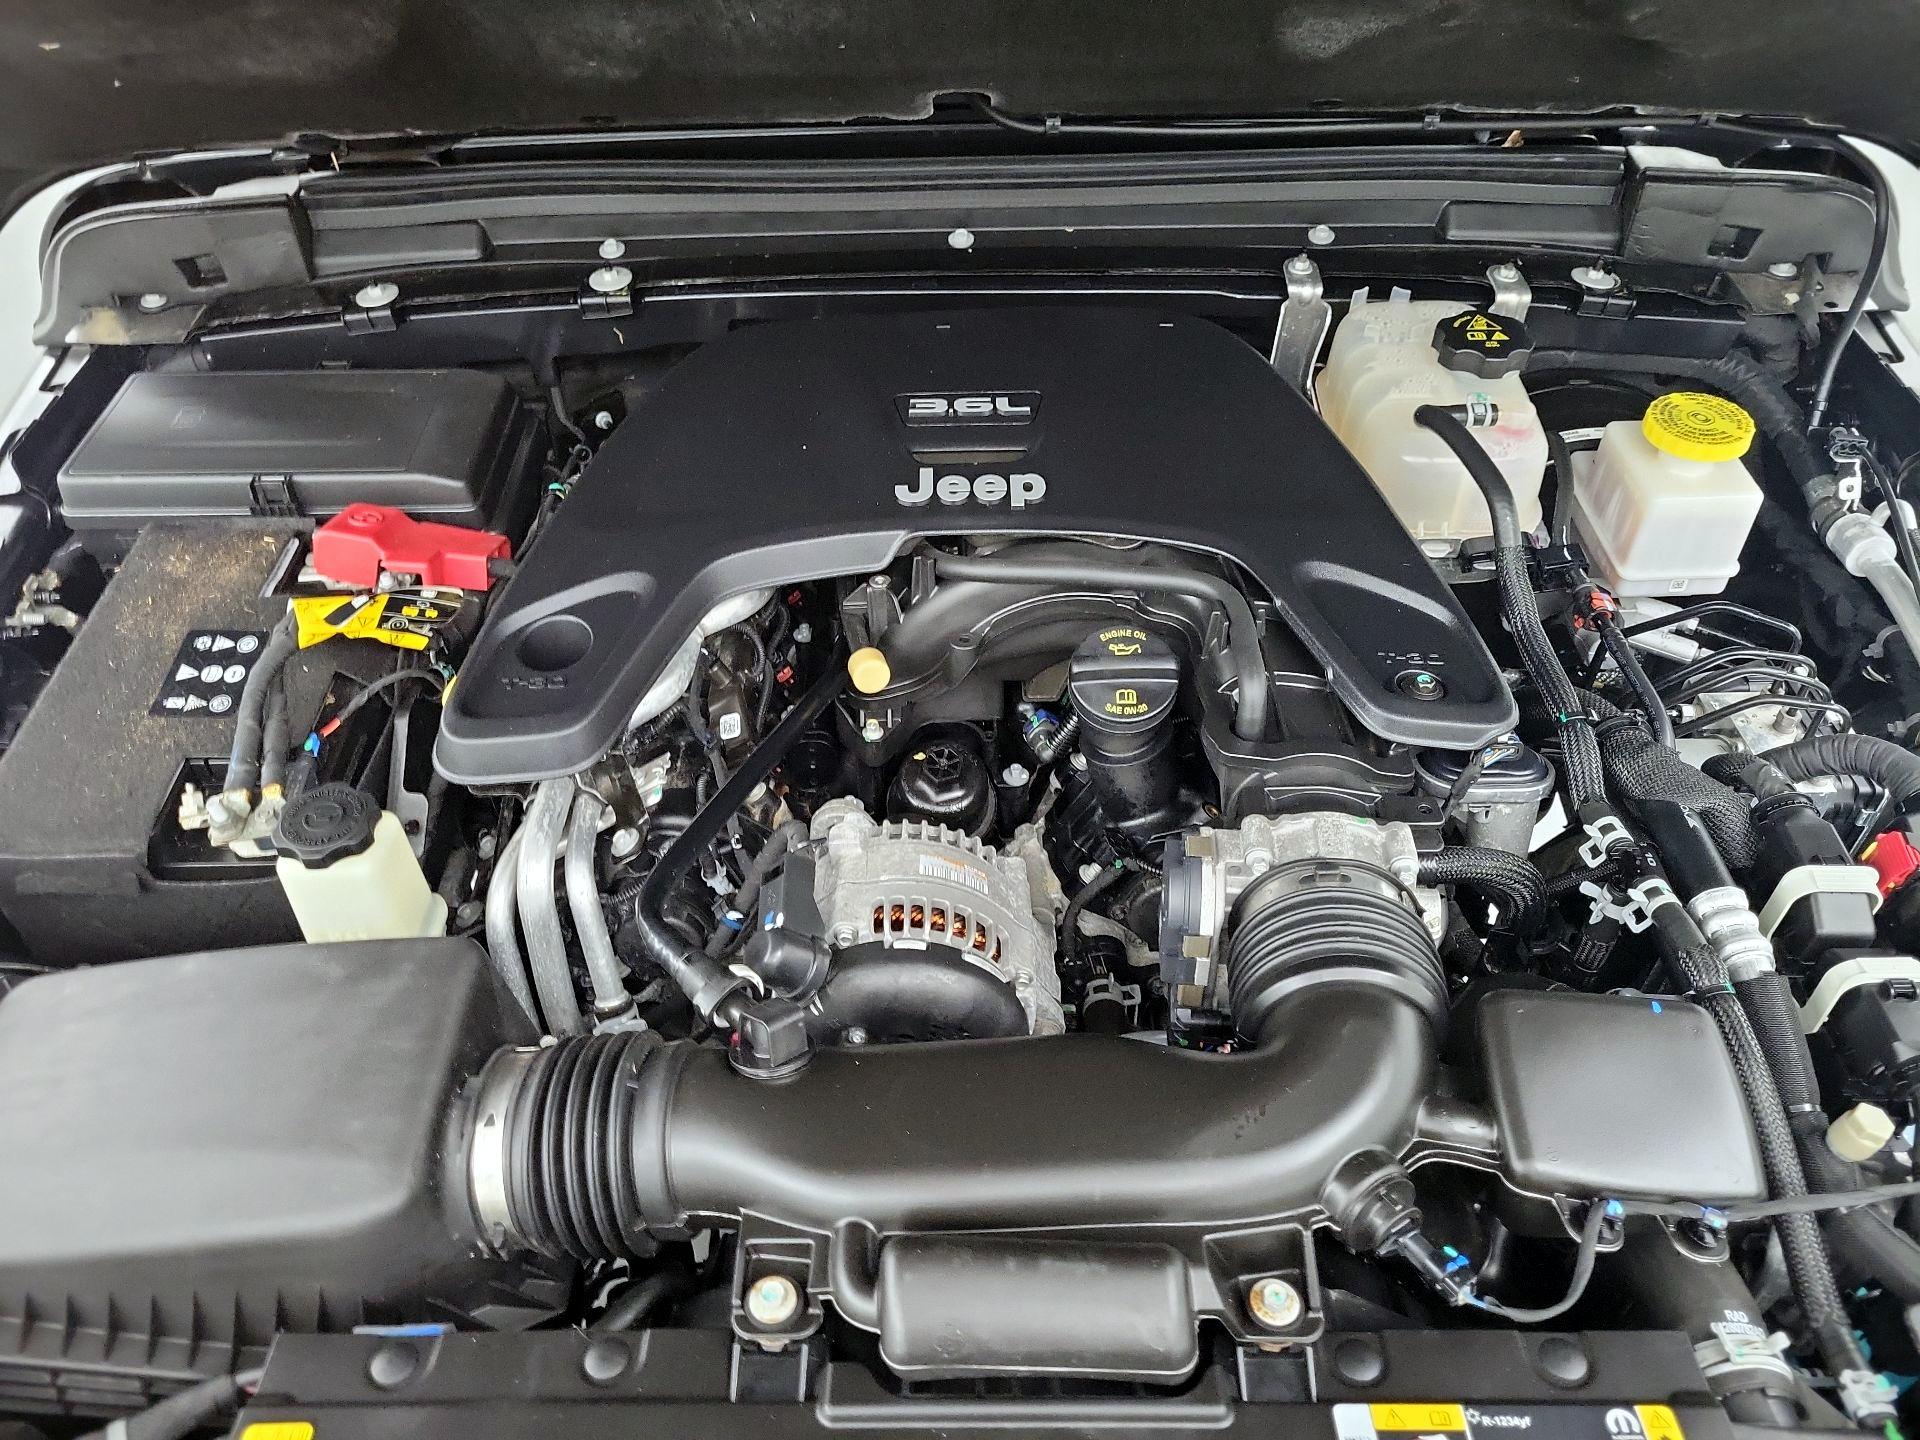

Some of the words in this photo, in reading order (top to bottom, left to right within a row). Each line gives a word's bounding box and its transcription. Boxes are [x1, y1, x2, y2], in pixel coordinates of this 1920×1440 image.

[908, 396, 1031, 417] 3.6L
[894, 467, 1047, 510] Jeep
[1099, 629, 1132, 642] ENGINE
[1133, 630, 1147, 641] OIL
[1105, 703, 1123, 715] SAE
[1123, 703, 1149, 715] 0W-20
[1723, 1309, 1750, 1323] RAD
[1481, 1415, 1532, 1429] R-1234yf
